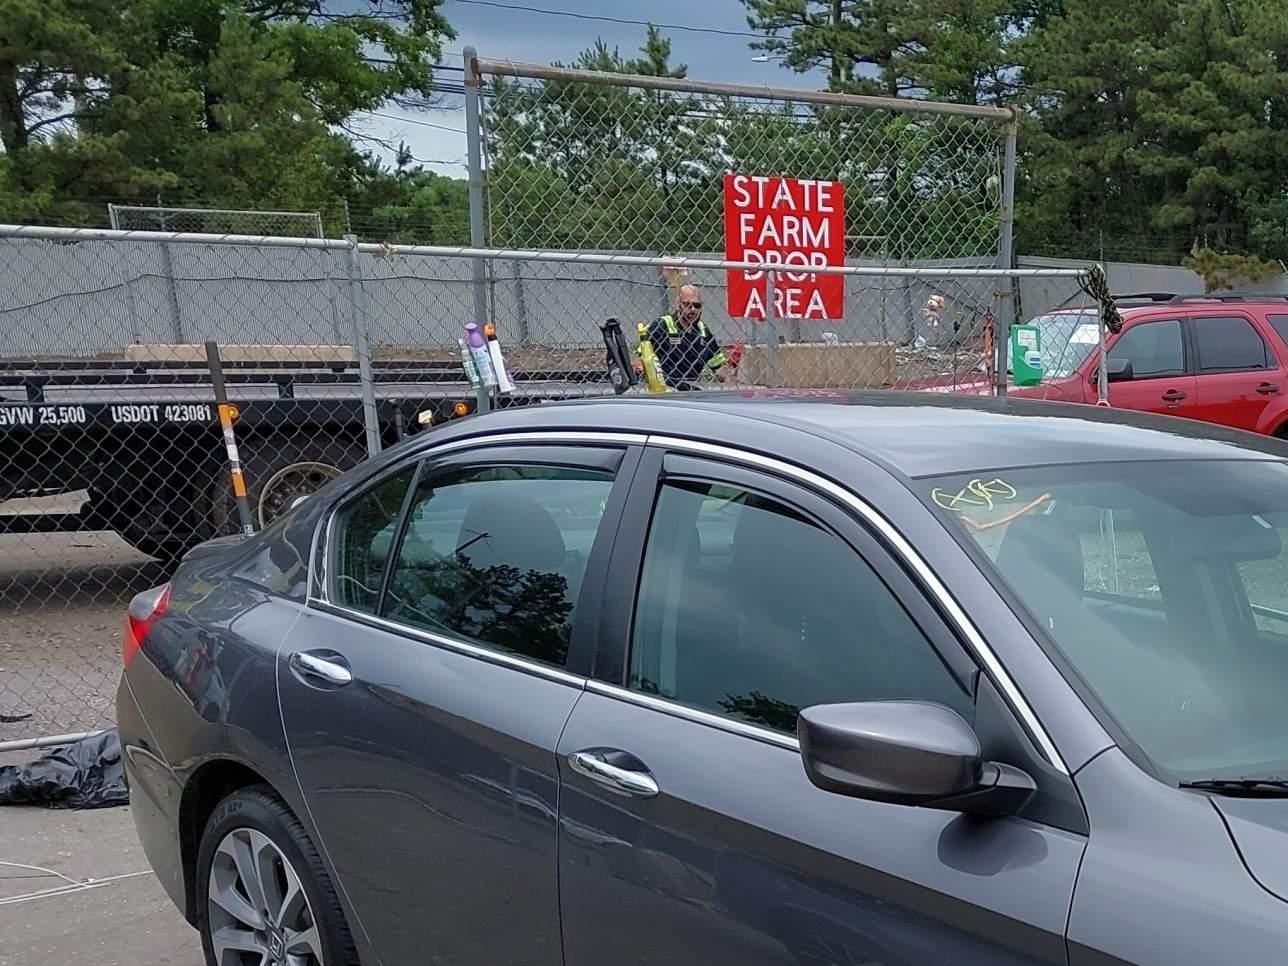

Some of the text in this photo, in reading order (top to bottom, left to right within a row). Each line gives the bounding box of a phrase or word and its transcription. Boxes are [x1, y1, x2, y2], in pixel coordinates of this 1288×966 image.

[733, 175, 834, 213] STATE
[740, 213, 830, 249] FARM
[743, 249, 828, 283] DROP
[743, 287, 829, 319] AREA
[0, 406, 86, 426] GVW 25,500
[111, 405, 212, 423] USDOT 423081
